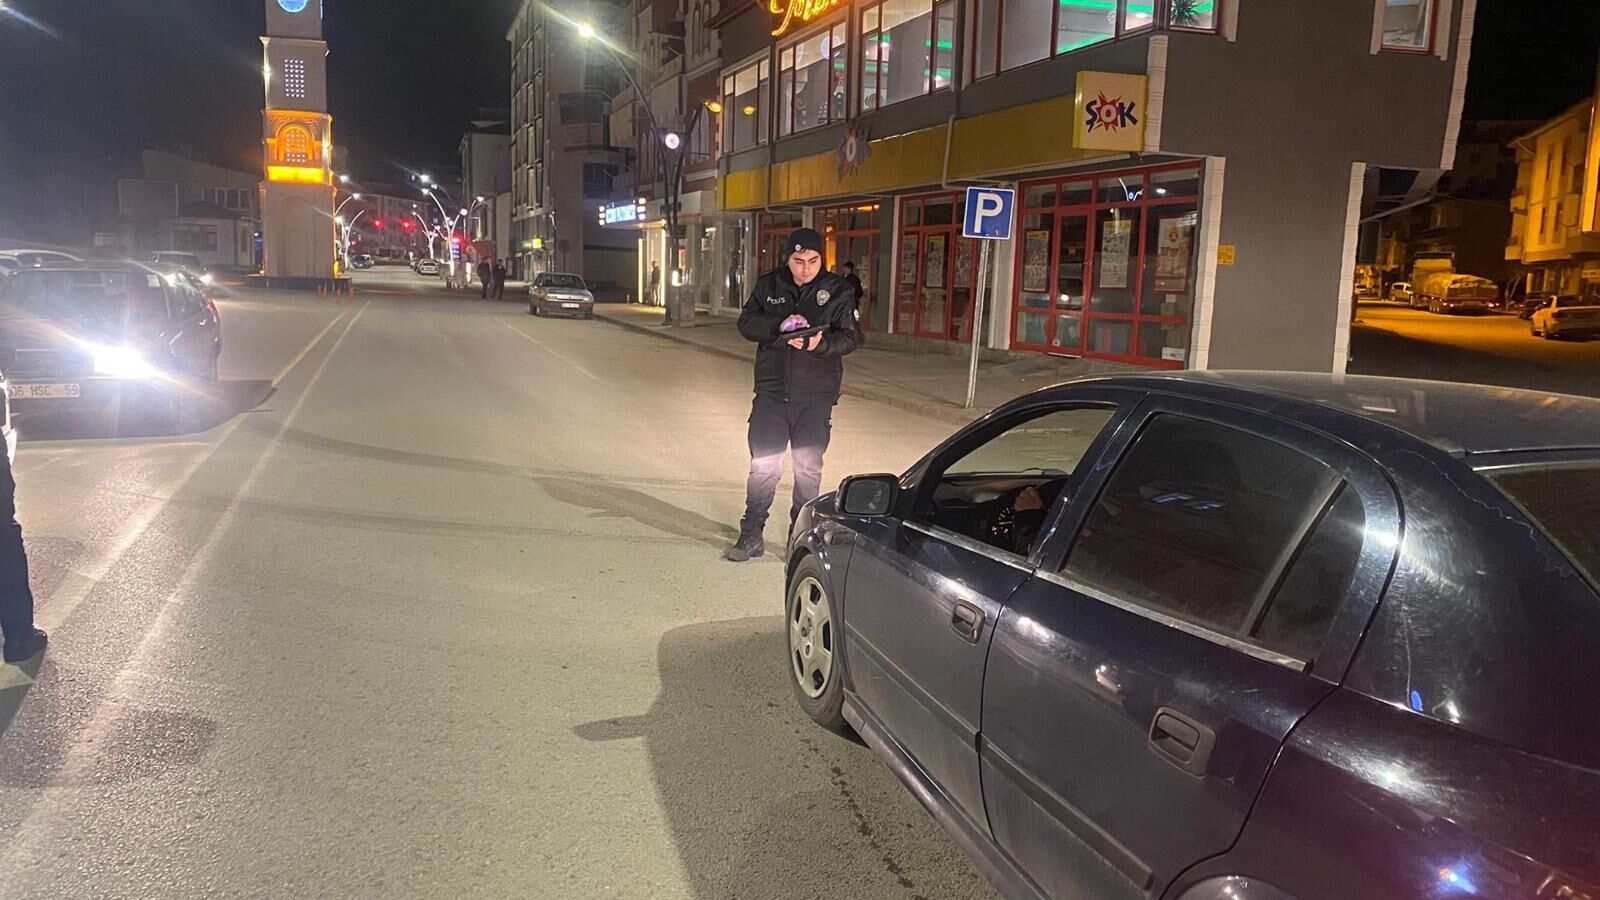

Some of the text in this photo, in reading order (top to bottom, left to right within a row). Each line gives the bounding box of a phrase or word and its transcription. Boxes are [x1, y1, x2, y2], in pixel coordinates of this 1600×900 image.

[1085, 99, 1138, 133] ŞOK
[974, 192, 1003, 233] P
[64, 384, 79, 396] 59
